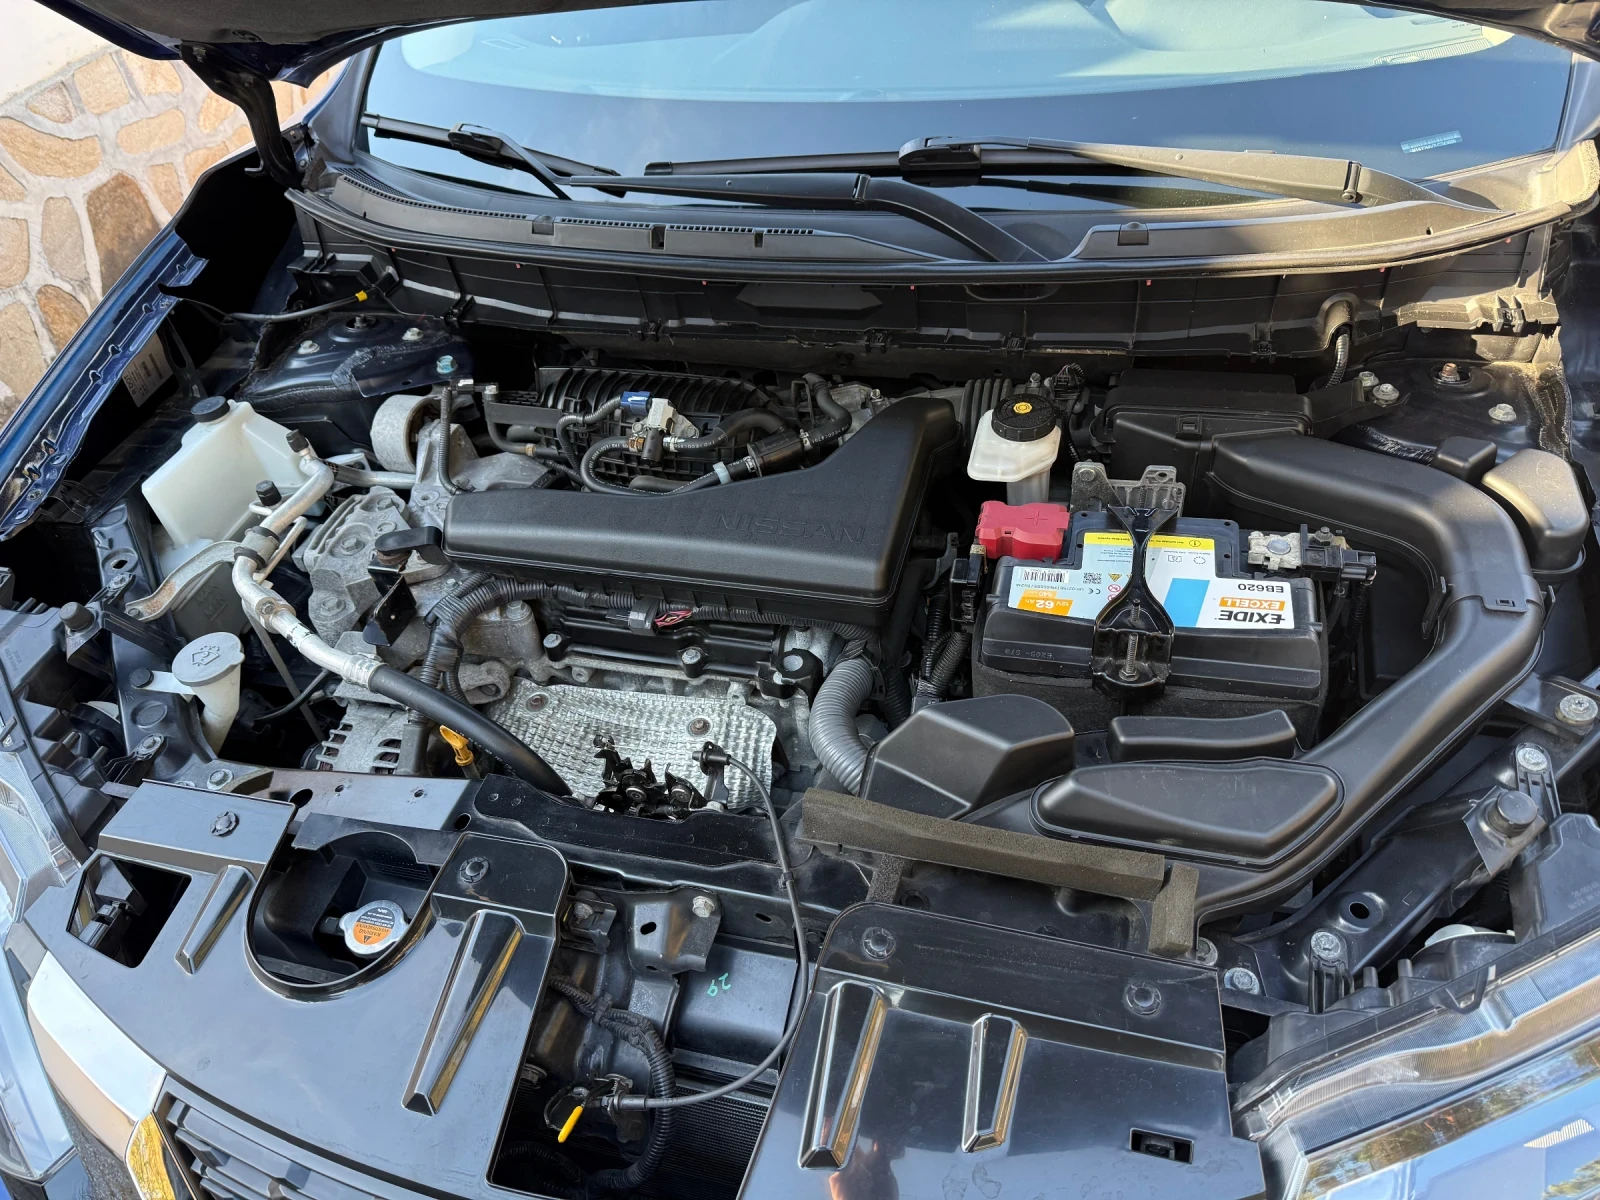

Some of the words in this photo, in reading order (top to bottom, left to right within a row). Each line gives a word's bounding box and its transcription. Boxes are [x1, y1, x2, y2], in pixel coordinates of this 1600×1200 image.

[714, 513, 867, 544] NISSAN
[1237, 583, 1284, 593] EB620
[1035, 599, 1055, 609] 62
[1223, 598, 1281, 610] EXCELL
[1217, 609, 1286, 625] EXIDE
[706, 972, 731, 997] 29
